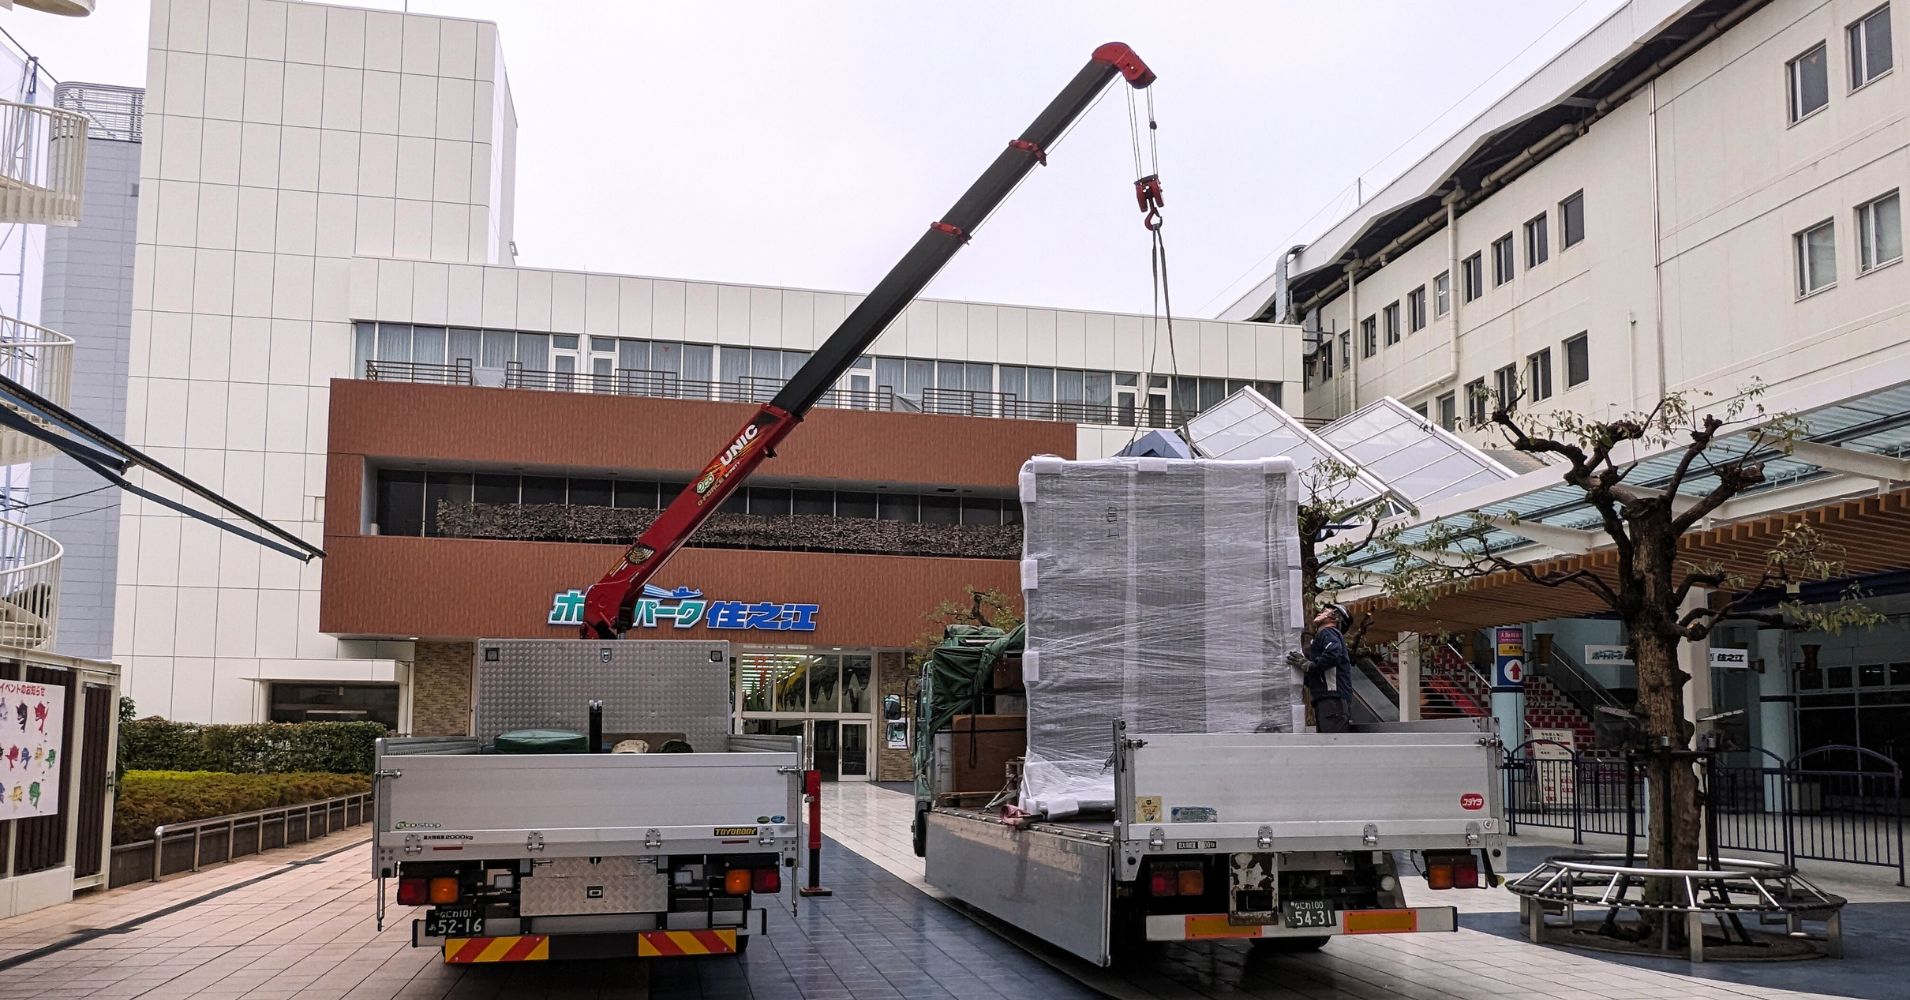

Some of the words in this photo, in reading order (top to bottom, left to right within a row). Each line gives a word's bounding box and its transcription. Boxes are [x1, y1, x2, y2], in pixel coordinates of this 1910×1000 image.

[720, 424, 758, 466] UNIC
[707, 601, 819, 630] 住之江
[1717, 653, 1745, 662] 住之江
[715, 828, 757, 836] TOYOBODY
[438, 917, 482, 934] 52-16
[1294, 910, 1332, 926] 54-31
